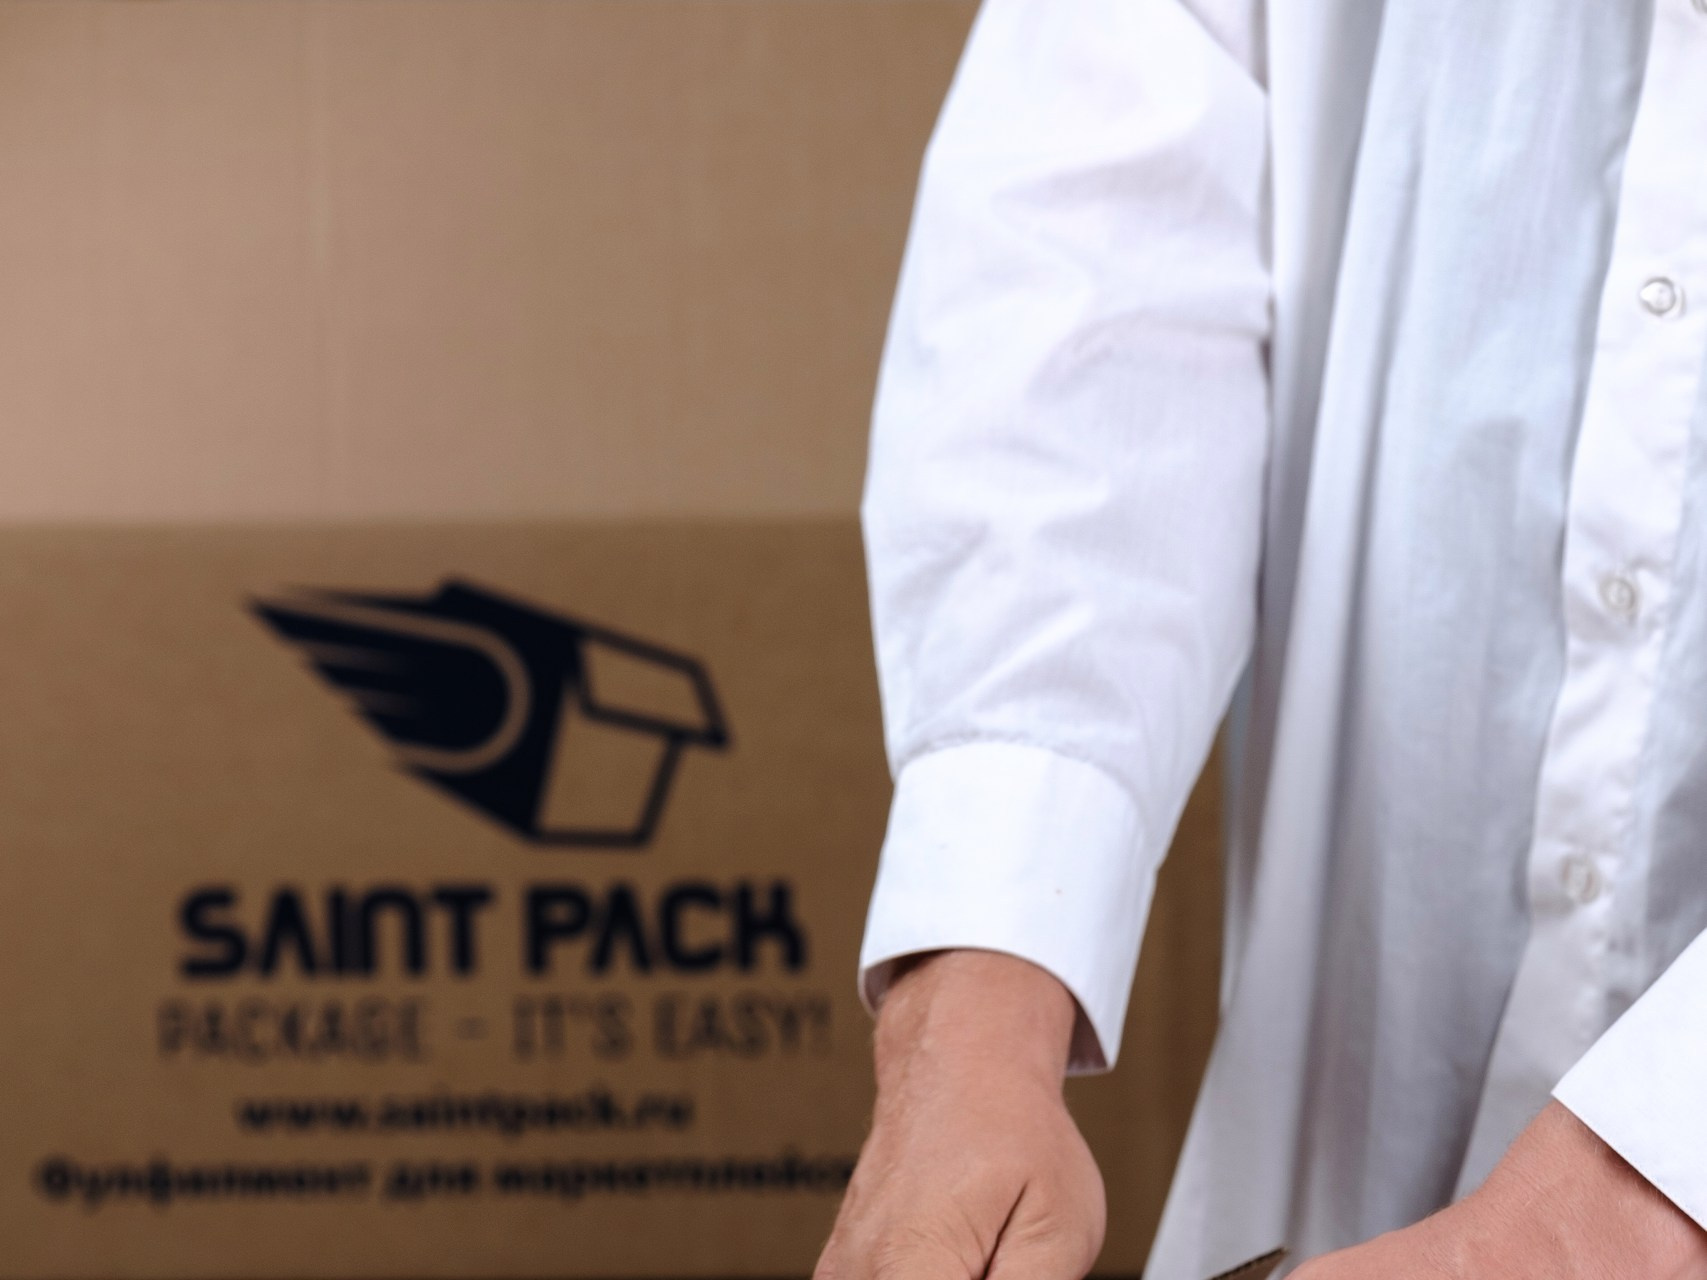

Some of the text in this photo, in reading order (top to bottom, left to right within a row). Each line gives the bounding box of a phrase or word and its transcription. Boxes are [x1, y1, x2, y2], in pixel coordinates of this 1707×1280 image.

[176, 879, 809, 981] SAINT PACK
[159, 998, 430, 1063] PACKAGE
[512, 996, 631, 1061] IT'S
[655, 993, 832, 1060] EASY!
[236, 1086, 694, 1141] www.saintpack.ru
[384, 1160, 480, 1205] для
